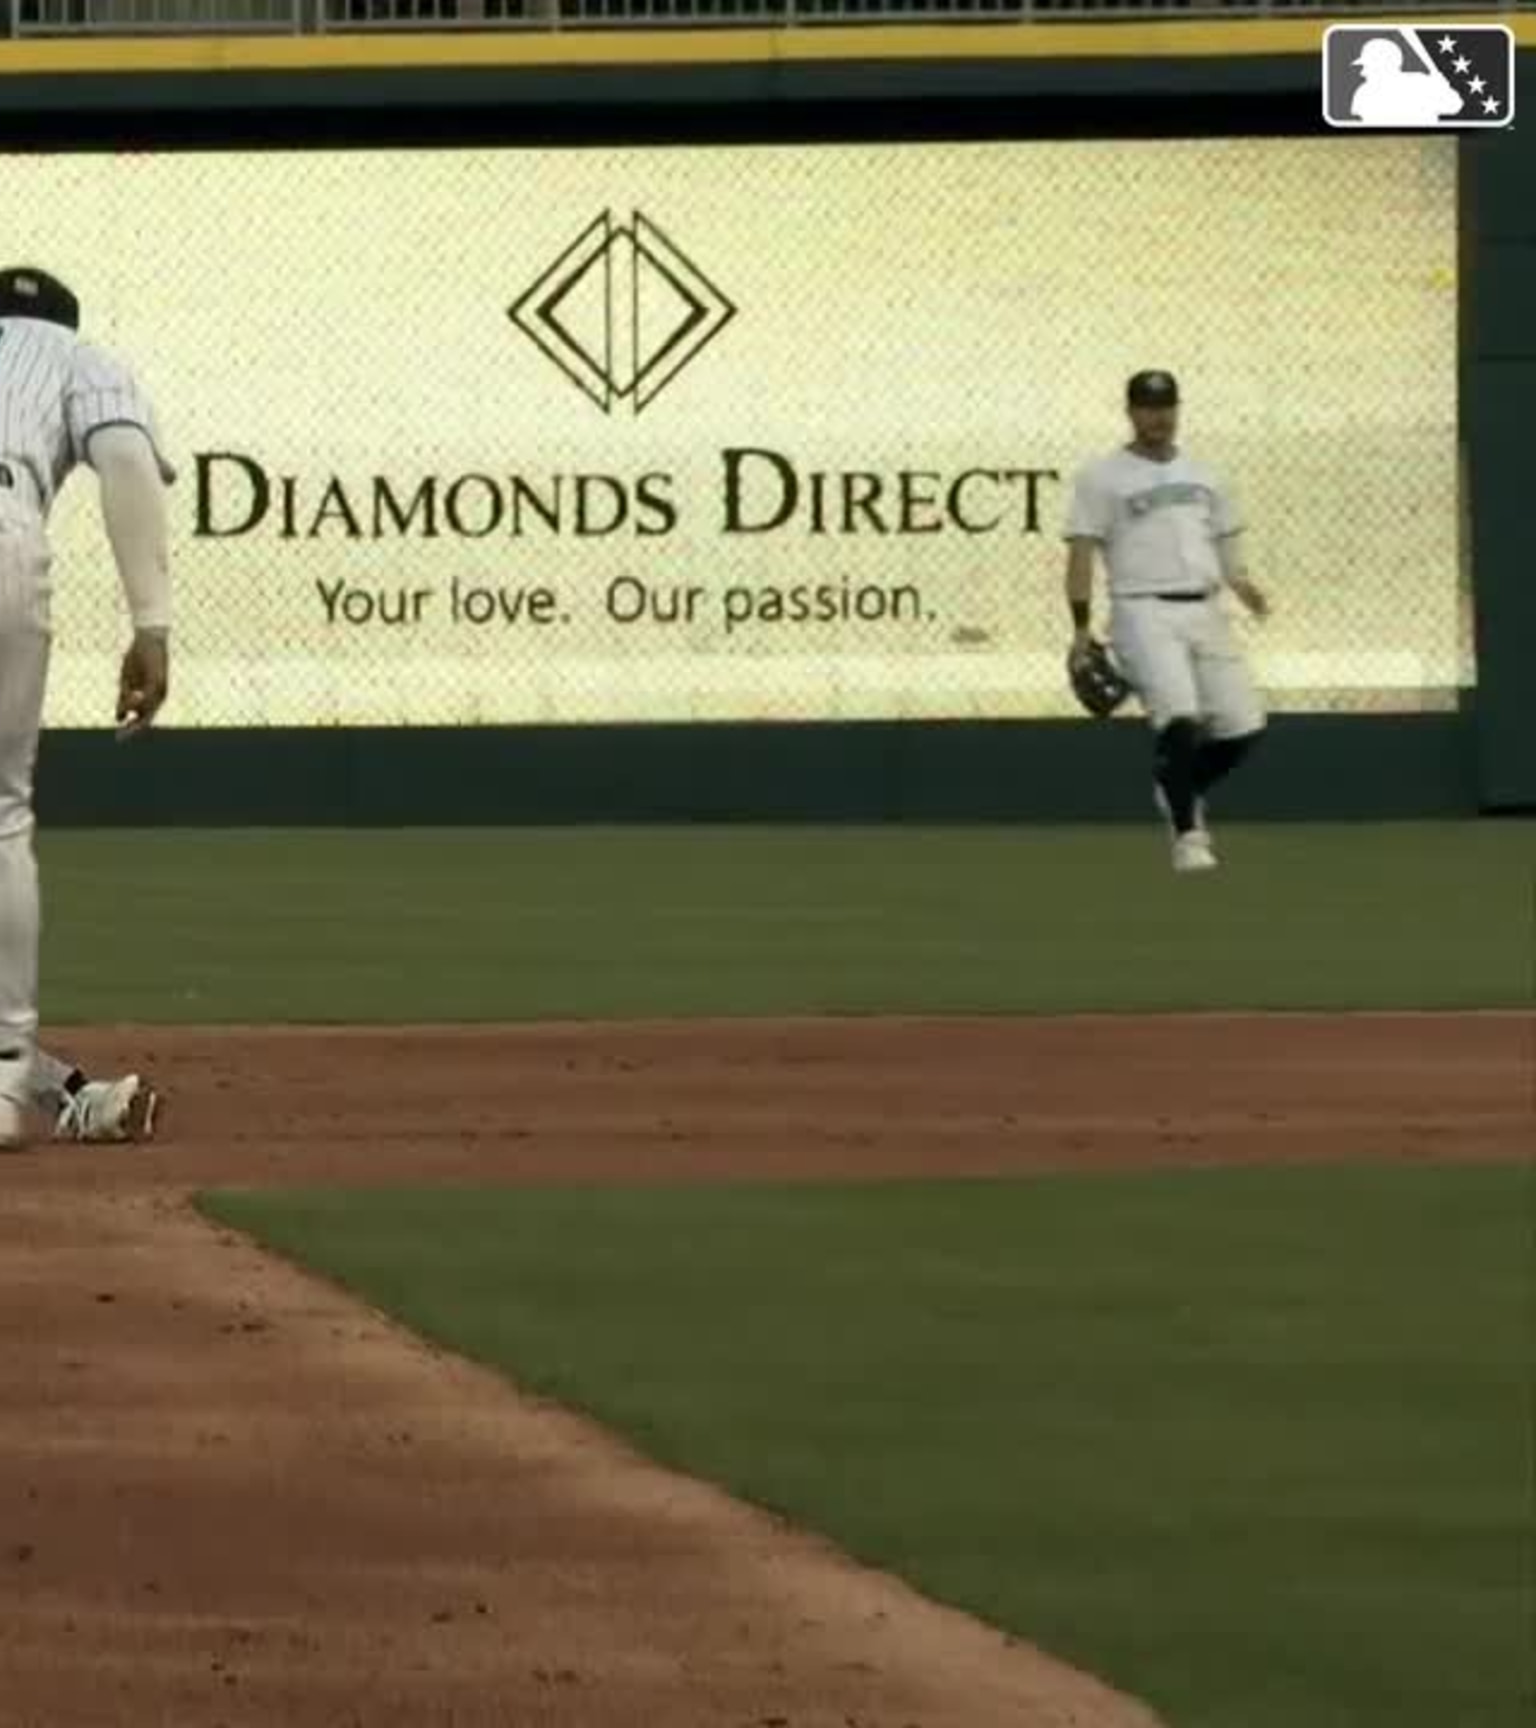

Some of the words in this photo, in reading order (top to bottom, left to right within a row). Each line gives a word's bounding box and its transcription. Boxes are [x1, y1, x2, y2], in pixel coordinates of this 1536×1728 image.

[193, 452, 677, 539] DIAMONDS
[721, 448, 1060, 534] DIRECT
[316, 580, 430, 625] Your
[451, 577, 571, 625] love.
[606, 576, 704, 624] Our
[724, 575, 937, 634] passion.
